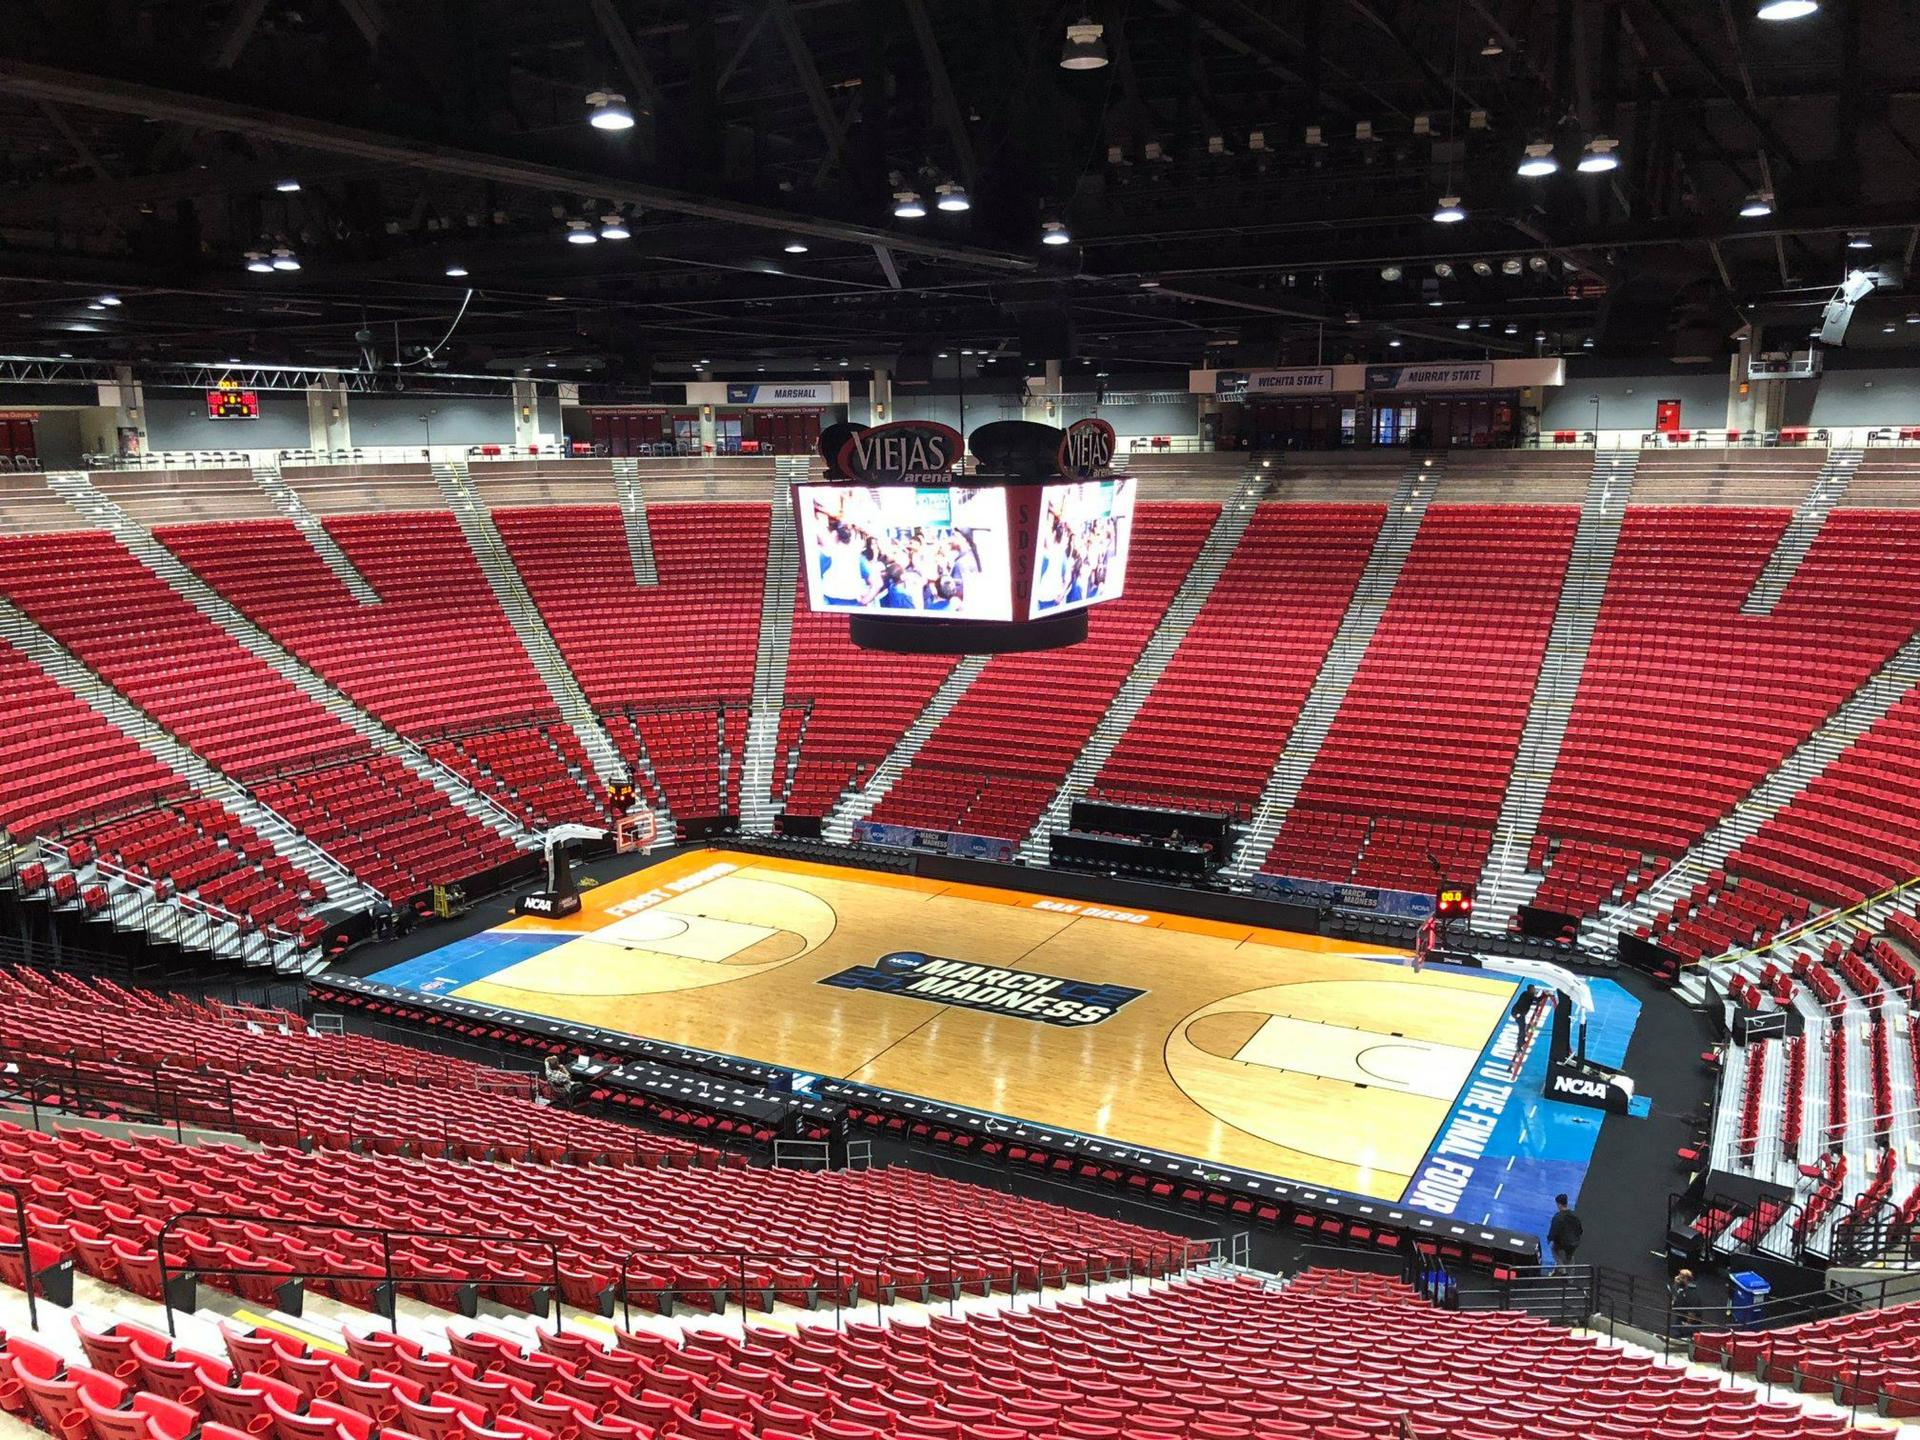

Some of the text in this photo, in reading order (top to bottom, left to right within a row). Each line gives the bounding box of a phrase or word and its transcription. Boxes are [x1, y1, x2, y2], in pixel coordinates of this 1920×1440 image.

[1258, 375, 1324, 387] WICHITA STATE
[1409, 370, 1481, 383] MURRAY STATE
[774, 389, 817, 399] MARSHALL
[851, 431, 946, 480] VIEJAS
[1066, 427, 1109, 476] VIEJAS
[904, 472, 952, 483] arena
[920, 831, 939, 839] MARCH
[922, 839, 948, 848] MADNESS
[1340, 888, 1367, 899] MARCH
[1441, 891, 1462, 902] 00.0
[524, 897, 554, 911] NCAA
[1343, 895, 1378, 908] MADNESS
[1411, 904, 1431, 912] NCAA
[1032, 900, 1150, 924] SAN DIEGO
[888, 957, 920, 968] NCAA
[914, 959, 1062, 995] MARCH
[905, 976, 1111, 1023] MADNESS
[1554, 1076, 1608, 1099] NCAA
[1462, 1080, 1513, 1115] THE
[1437, 1109, 1498, 1160] FINAL
[1408, 1156, 1474, 1215] FOUR
